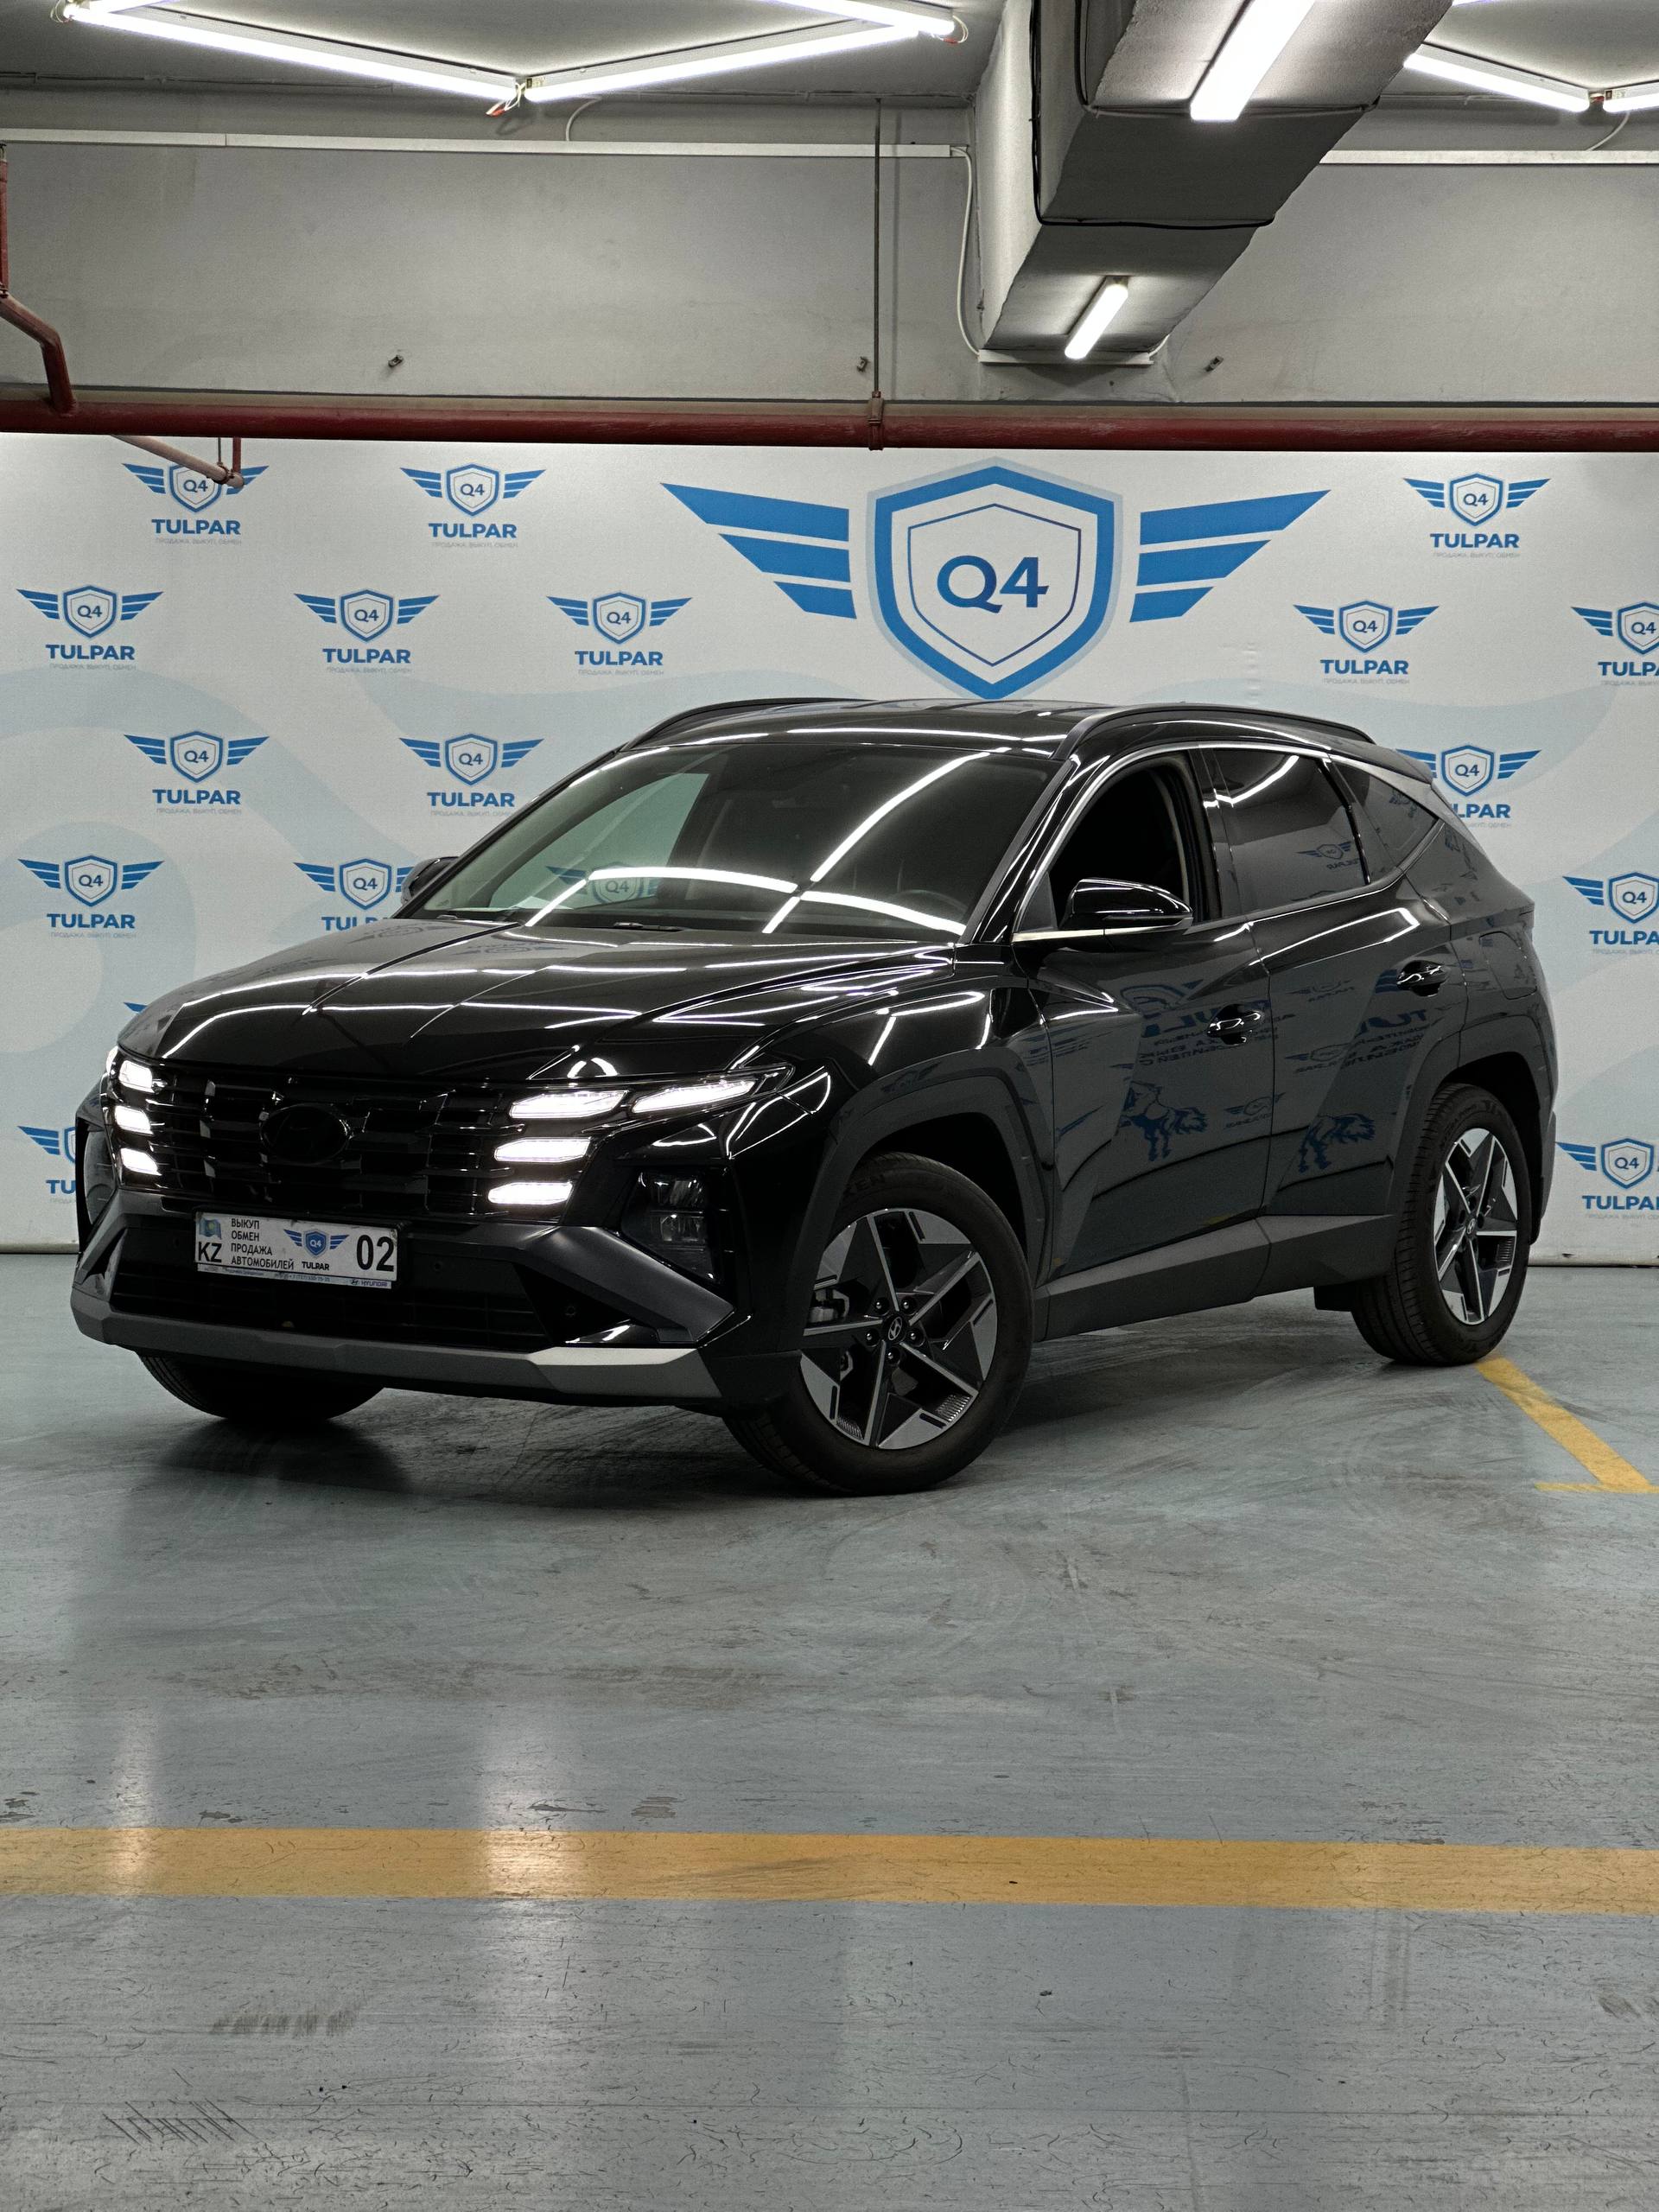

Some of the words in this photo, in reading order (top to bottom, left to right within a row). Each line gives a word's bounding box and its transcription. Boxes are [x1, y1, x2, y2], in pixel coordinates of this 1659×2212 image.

[183, 480, 208, 493] Q4
[460, 484, 485, 497] Q4
[1463, 493, 1488, 506] Q4
[151, 519, 241, 535] TULPAR
[429, 523, 518, 538] TULPAR
[1430, 533, 1520, 549] TULPAR
[937, 555, 1048, 613] Q4
[77, 605, 102, 618] Q4
[353, 609, 378, 622] Q4
[607, 612, 632, 625] Q4
[1352, 620, 1378, 633] Q4
[1630, 622, 1656, 635] Q4
[46, 644, 135, 660] TULPAR
[322, 648, 411, 664] TULPAR
[575, 651, 664, 666] TULPAR
[1320, 659, 1409, 675] TULPAR
[1598, 661, 1659, 677] TULPA
[183, 750, 209, 763] Q4
[458, 753, 484, 766] Q4
[1455, 764, 1479, 777] Q4
[152, 789, 241, 804] TULPAR
[427, 791, 515, 807] TULPAR
[79, 874, 103, 887] Q4
[353, 878, 378, 891] Q4
[1622, 892, 1647, 905] Q4
[47, 913, 135, 929] TULPAR
[1590, 930, 1659, 945] TULPA
[1614, 1157, 1639, 1170] Q4
[1582, 1195, 1659, 1211] TULPA
[231, 1217, 259, 1230] ВЫКУП
[231, 1230, 259, 1242] ОБМЕН
[231, 1243, 272, 1255] ПРОДАЖА
[309, 1239, 321, 1248] Q4
[198, 1241, 222, 1262] KZ
[357, 1235, 394, 1272] 02
[231, 1255, 294, 1269] АВТОМОБИЛЕЙ
[302, 1261, 330, 1270] TULPAR
